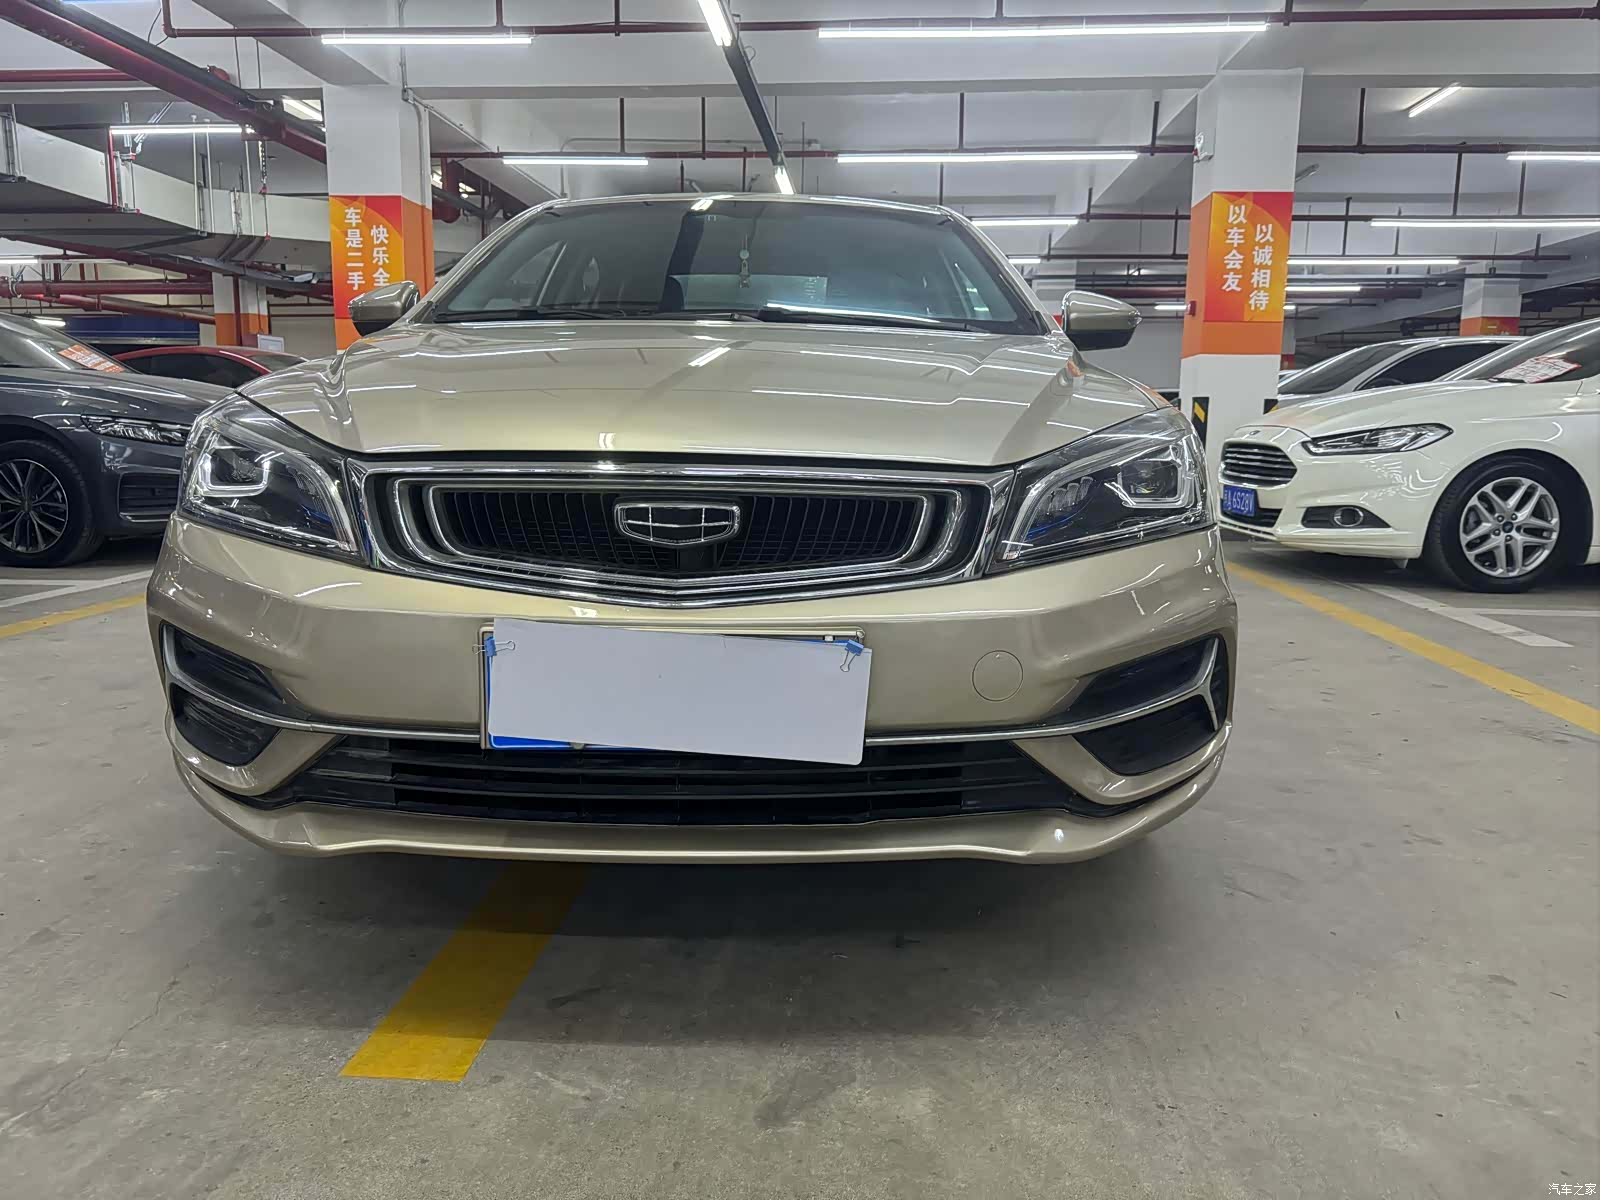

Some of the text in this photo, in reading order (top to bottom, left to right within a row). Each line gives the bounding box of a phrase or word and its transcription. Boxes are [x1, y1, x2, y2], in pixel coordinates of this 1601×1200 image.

[344, 207, 365, 291] 车是二手
[370, 224, 390, 287] 快乐全
[1221, 204, 1247, 292] 以车会友
[1248, 223, 1274, 311] 以诚相待
